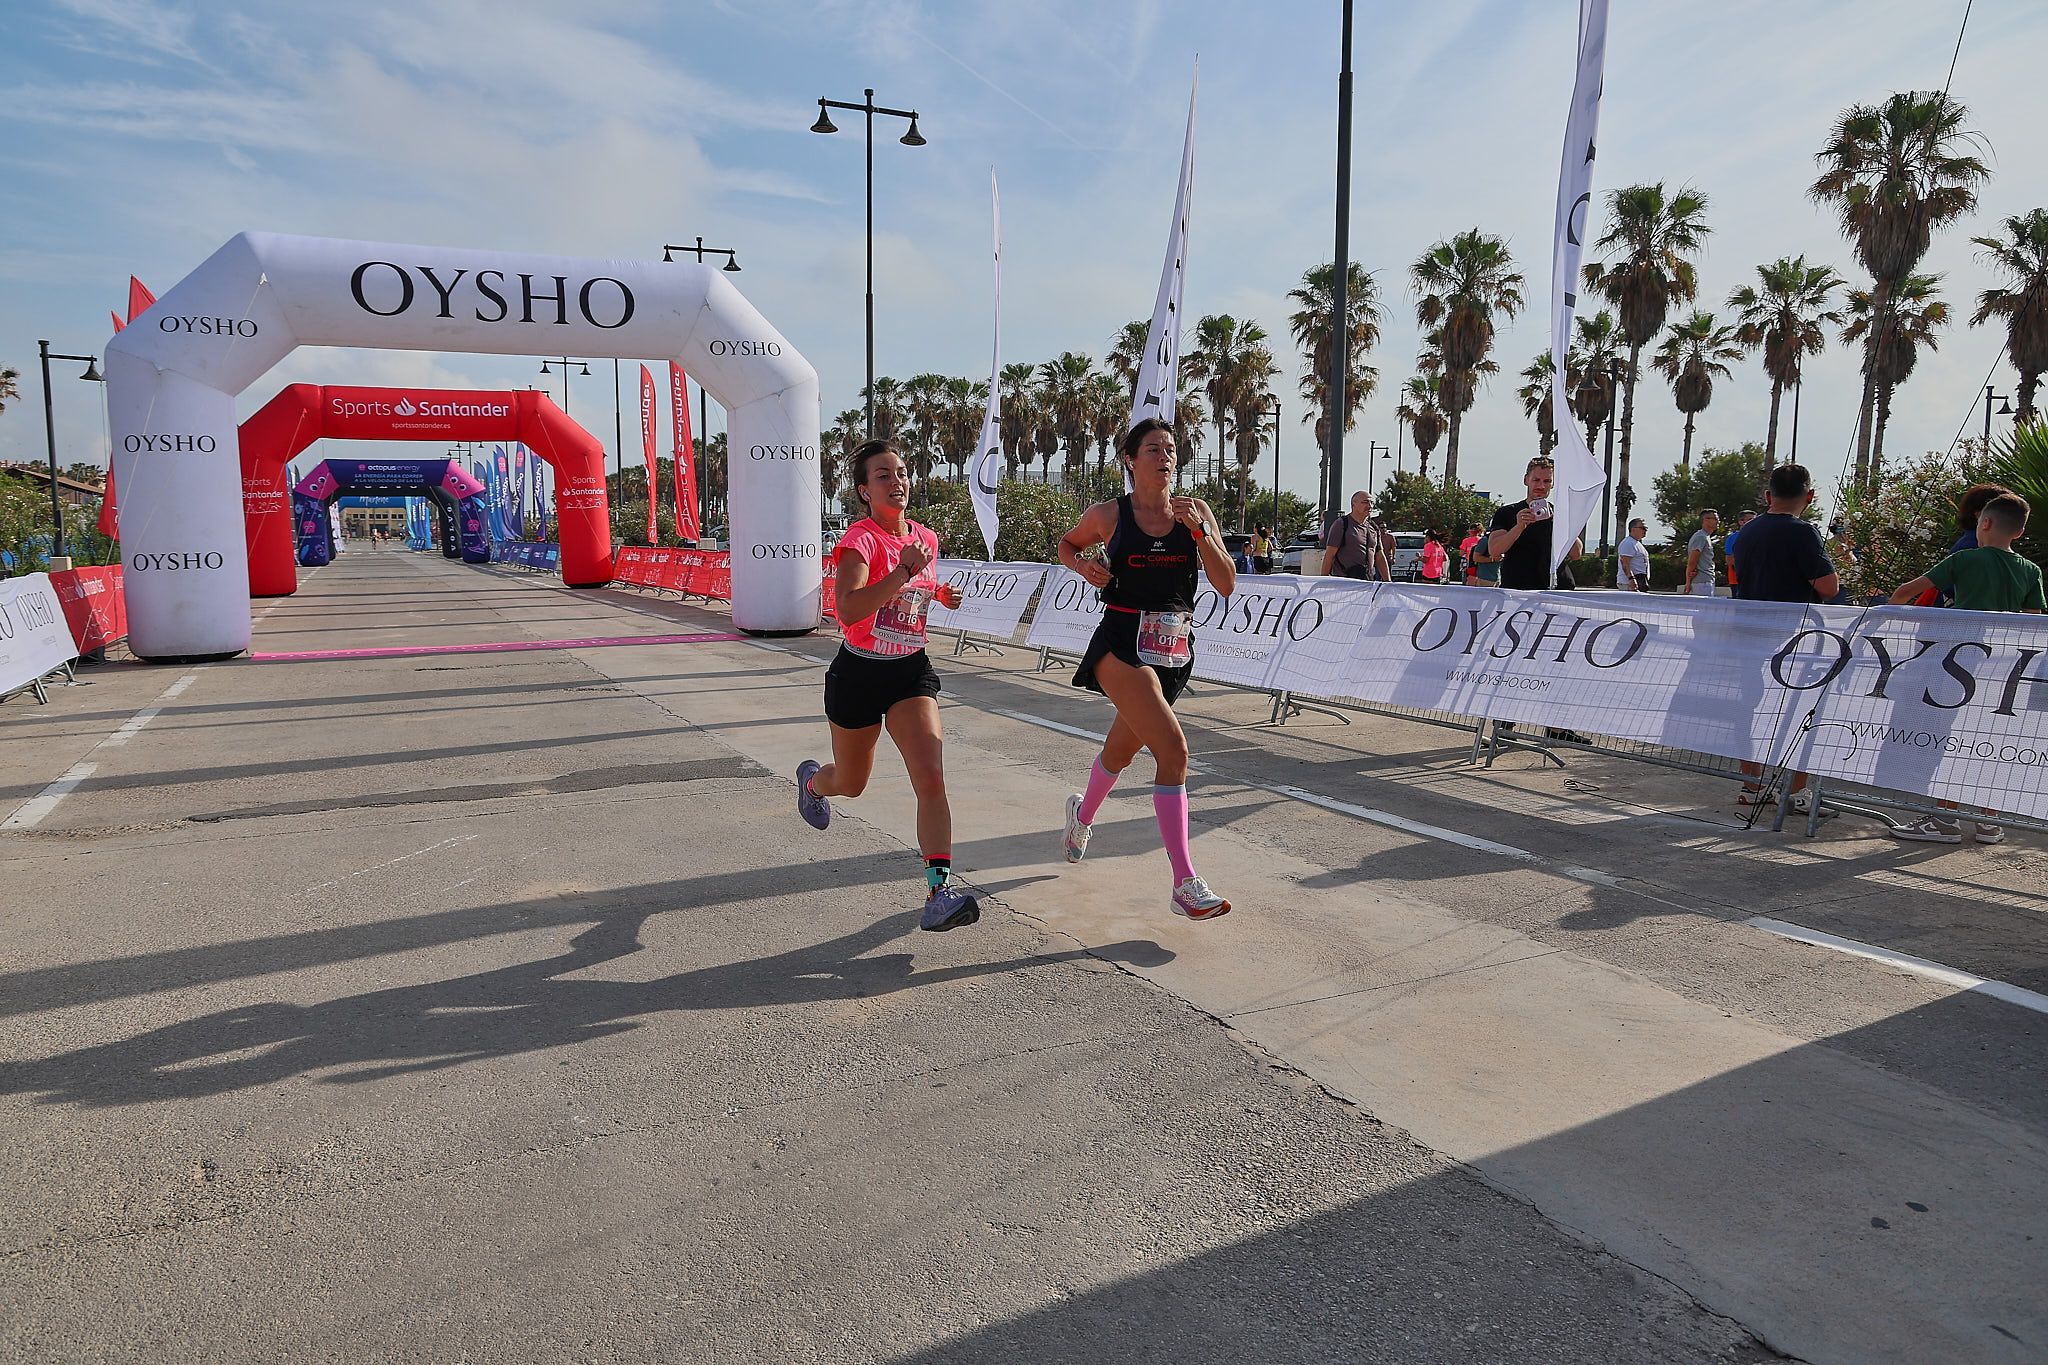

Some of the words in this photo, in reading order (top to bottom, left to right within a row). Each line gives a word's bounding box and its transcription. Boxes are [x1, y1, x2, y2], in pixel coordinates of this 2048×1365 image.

[350, 261, 635, 329] OYSHO
[159, 316, 258, 338] OYSHO
[709, 340, 781, 357] OYSHO
[332, 398, 391, 418] Sports
[419, 401, 509, 417] Santander
[124, 434, 216, 453] OYSHO
[750, 445, 815, 461] OYSHO
[243, 477, 271, 487] Sports
[572, 477, 597, 485] Sports
[571, 488, 605, 496] Santander
[752, 544, 816, 559] OYSHO
[134, 552, 223, 571] OYSHO
[897, 612, 918, 625] 016
[1189, 590, 1324, 641] OYSHO
[1159, 635, 1178, 646] 016
[1411, 607, 1648, 669] OYSHO
[1444, 669, 1551, 692] WWW.OYSHO.COM
